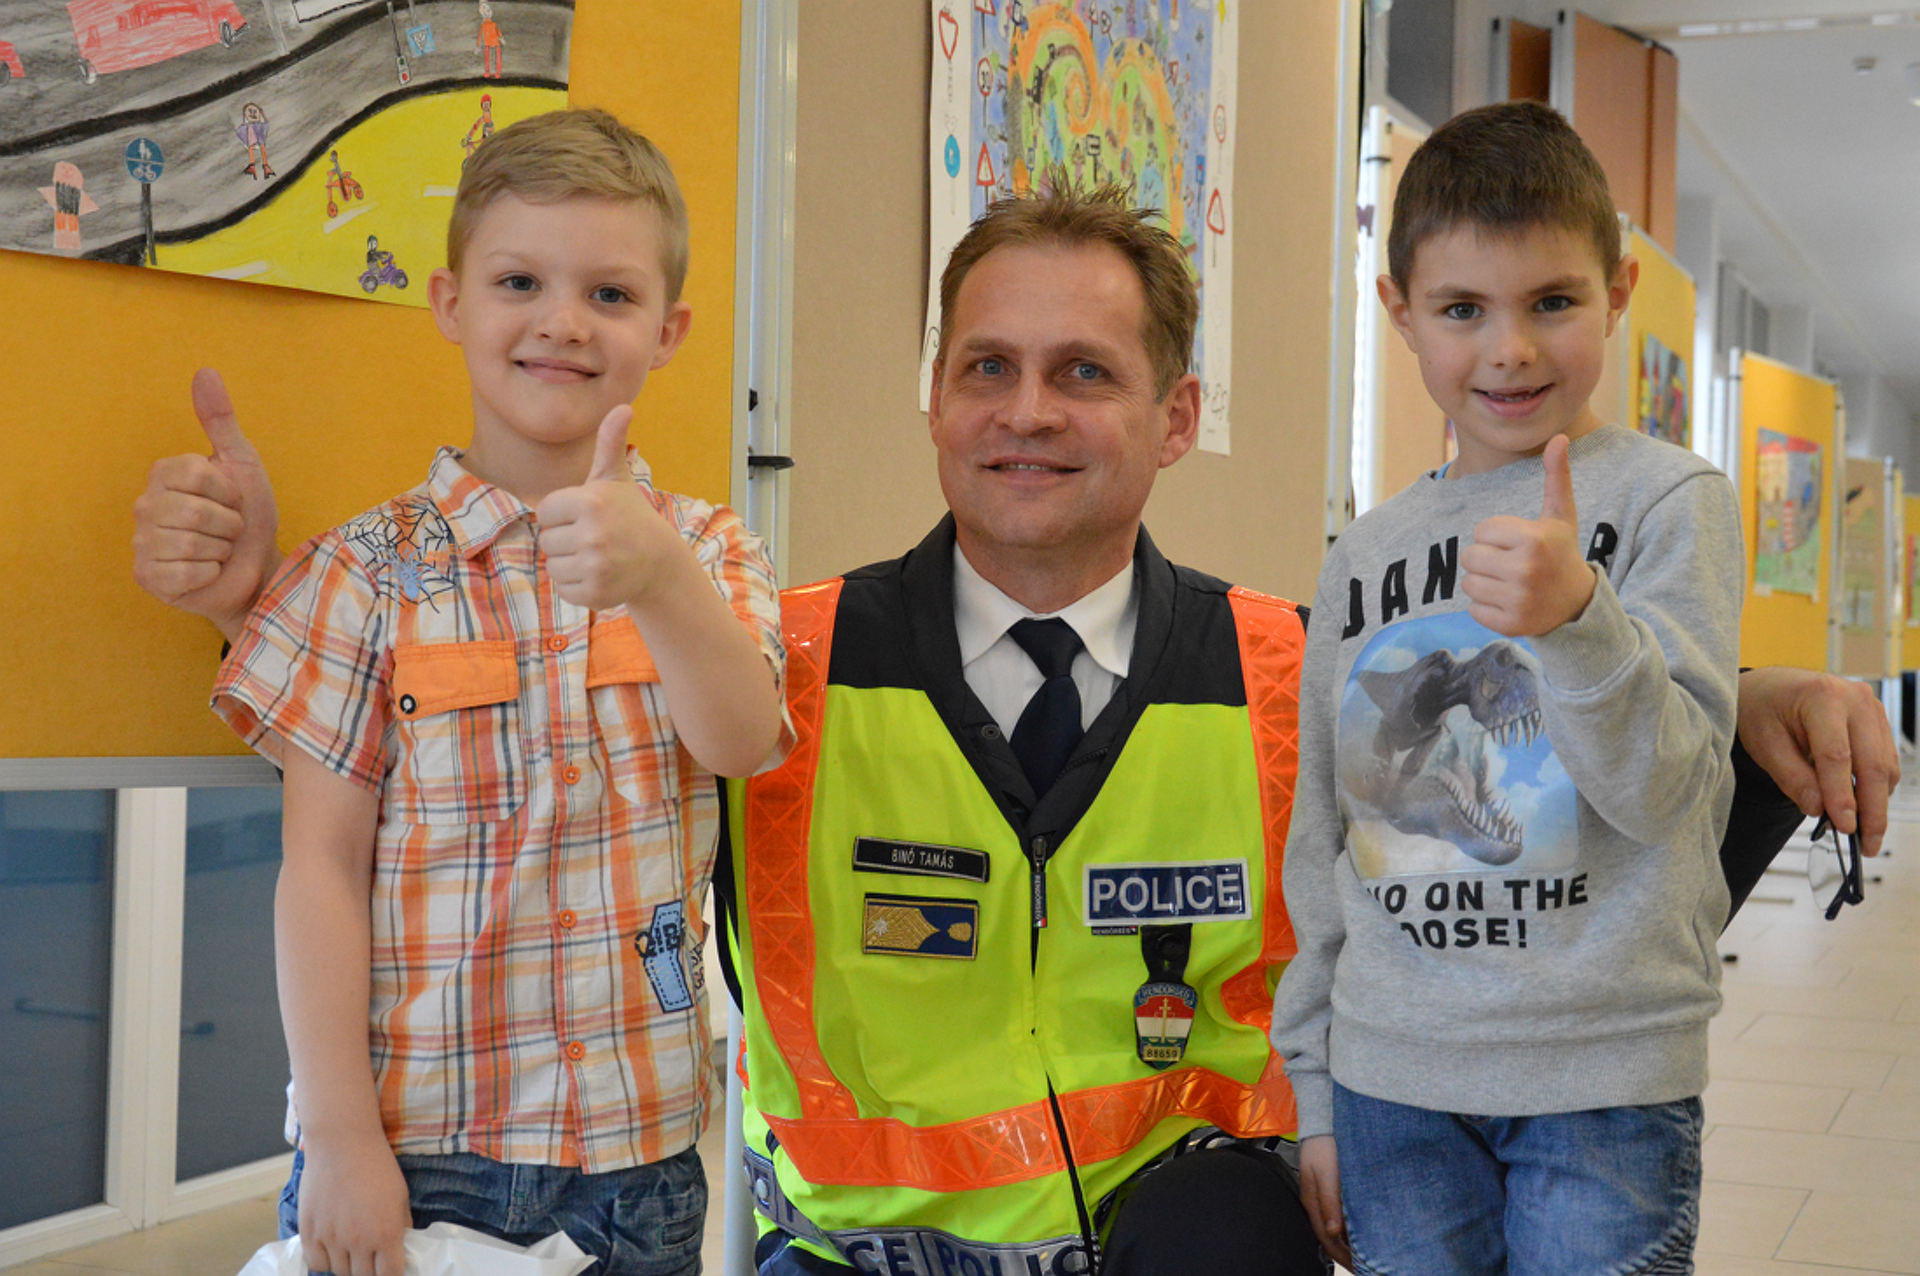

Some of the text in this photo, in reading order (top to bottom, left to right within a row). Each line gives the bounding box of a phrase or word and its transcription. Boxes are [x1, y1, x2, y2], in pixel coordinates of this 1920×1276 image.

[891, 846, 955, 869] BINÓ TAMÁS
[1092, 873, 1240, 912] POLICE
[1425, 880, 1484, 911] ON
[1504, 873, 1589, 911] THE
